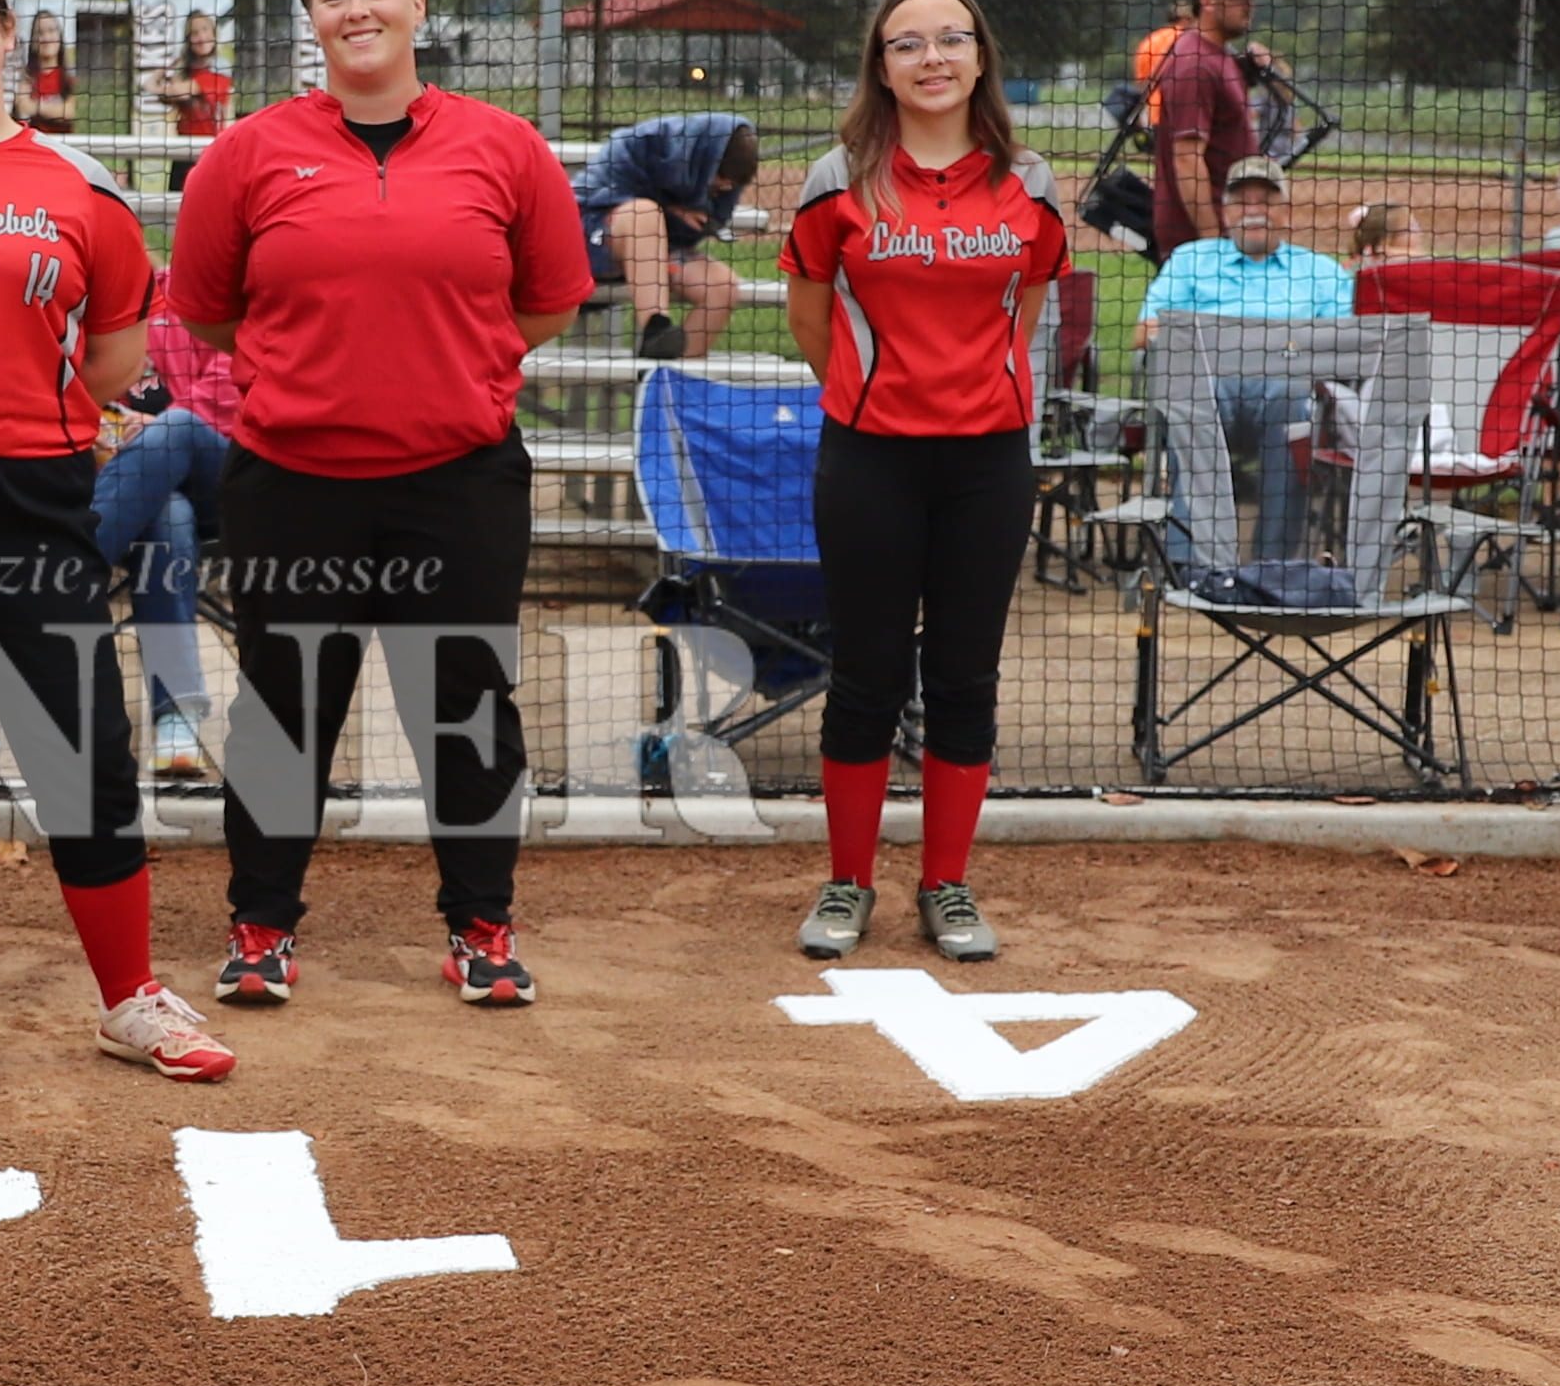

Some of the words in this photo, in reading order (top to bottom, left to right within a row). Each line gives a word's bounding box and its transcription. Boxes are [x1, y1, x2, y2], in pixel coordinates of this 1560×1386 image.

[867, 221, 936, 266] Lady
[941, 222, 1023, 260] Rebels
[23, 252, 62, 309] 14
[1002, 270, 1022, 317] 4
[773, 968, 1198, 1102] 4
